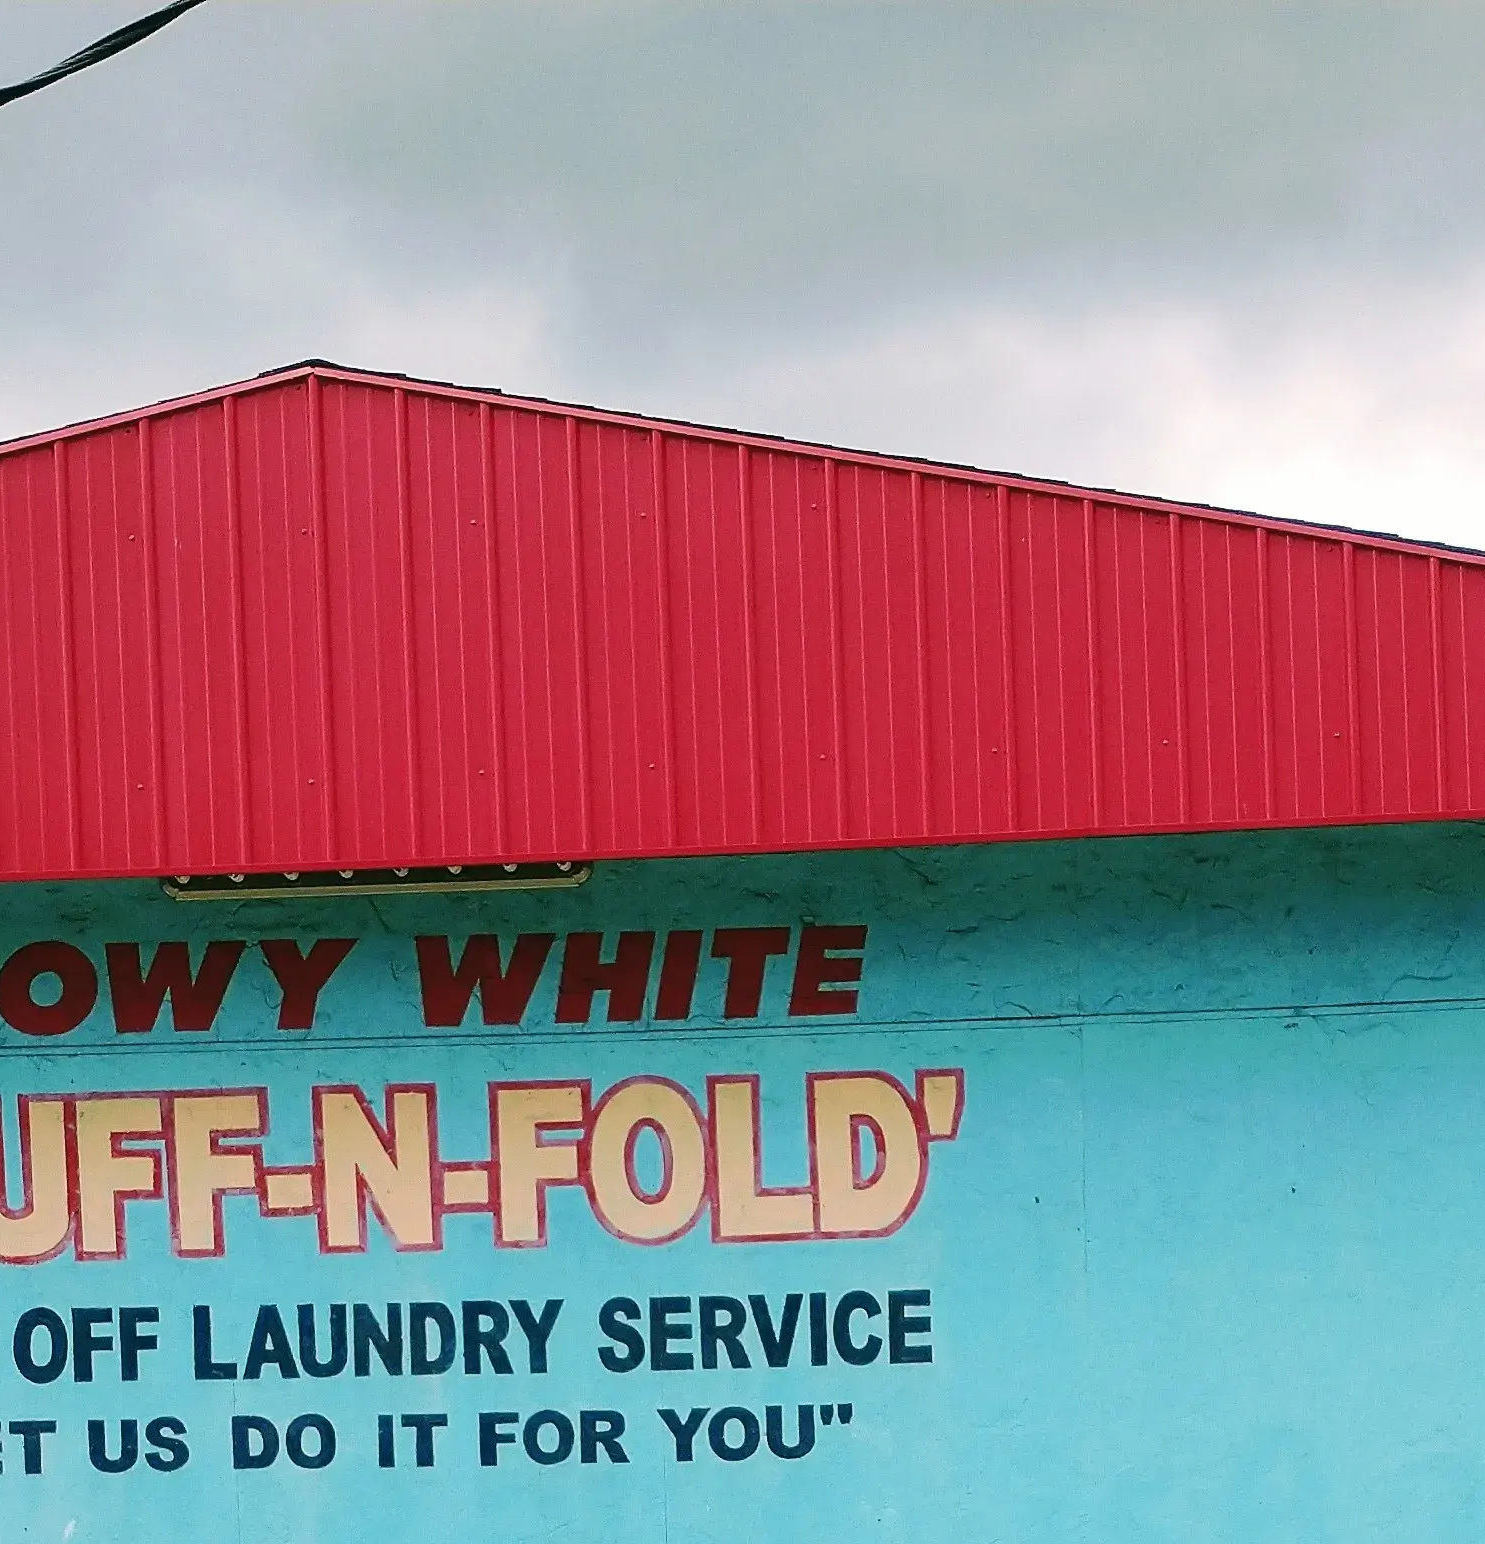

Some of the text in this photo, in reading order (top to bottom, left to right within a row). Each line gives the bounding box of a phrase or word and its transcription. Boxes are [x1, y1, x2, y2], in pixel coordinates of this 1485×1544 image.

[417, 925, 868, 1027] WHITE
[12, 1305, 161, 1383] OFF
[192, 1299, 566, 1380] LAUNDRY
[598, 1289, 933, 1372] SERVICE
[87, 1416, 191, 1472] US
[232, 1414, 338, 1470] DO
[378, 1412, 447, 1468] IT
[480, 1410, 631, 1466] FOR
[657, 1403, 854, 1462] YOU"
